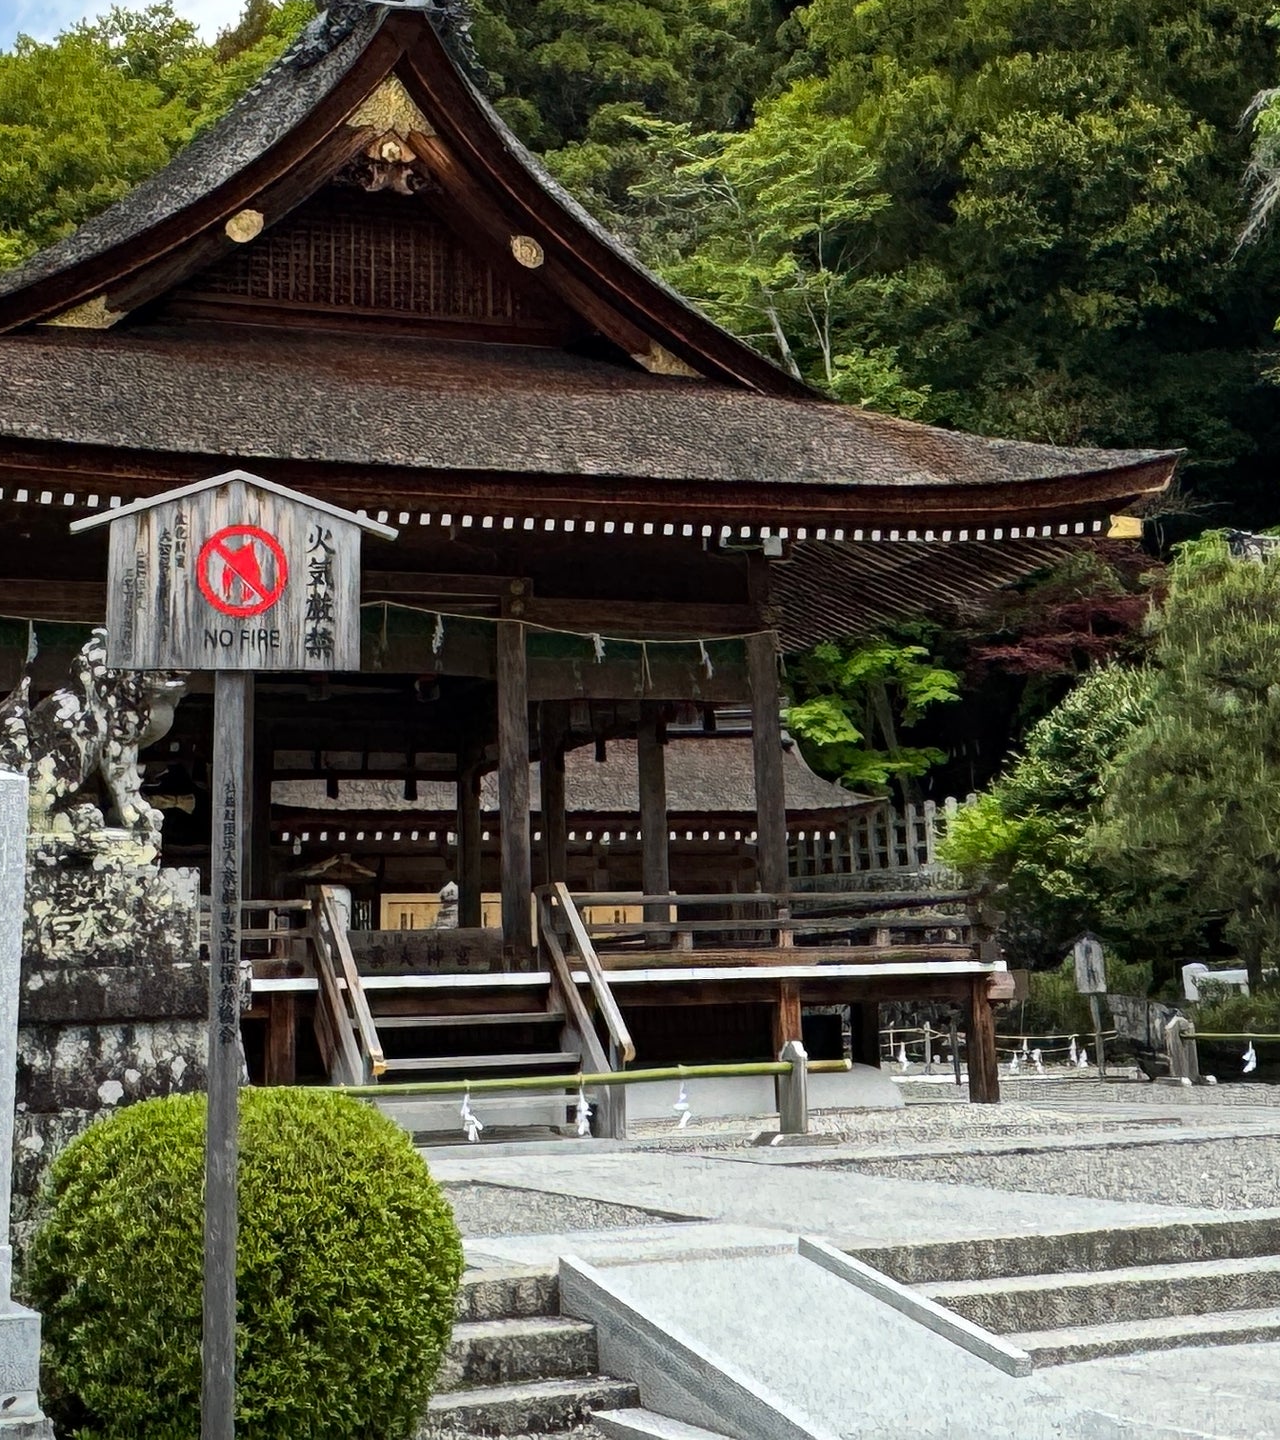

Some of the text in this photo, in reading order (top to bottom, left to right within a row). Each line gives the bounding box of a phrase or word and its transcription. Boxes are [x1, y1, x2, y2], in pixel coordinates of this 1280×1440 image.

[305, 524, 335, 661] 火気厳禁
[204, 629, 280, 650] NO FIRE
[368, 944, 472, 969] 雲大神宮
